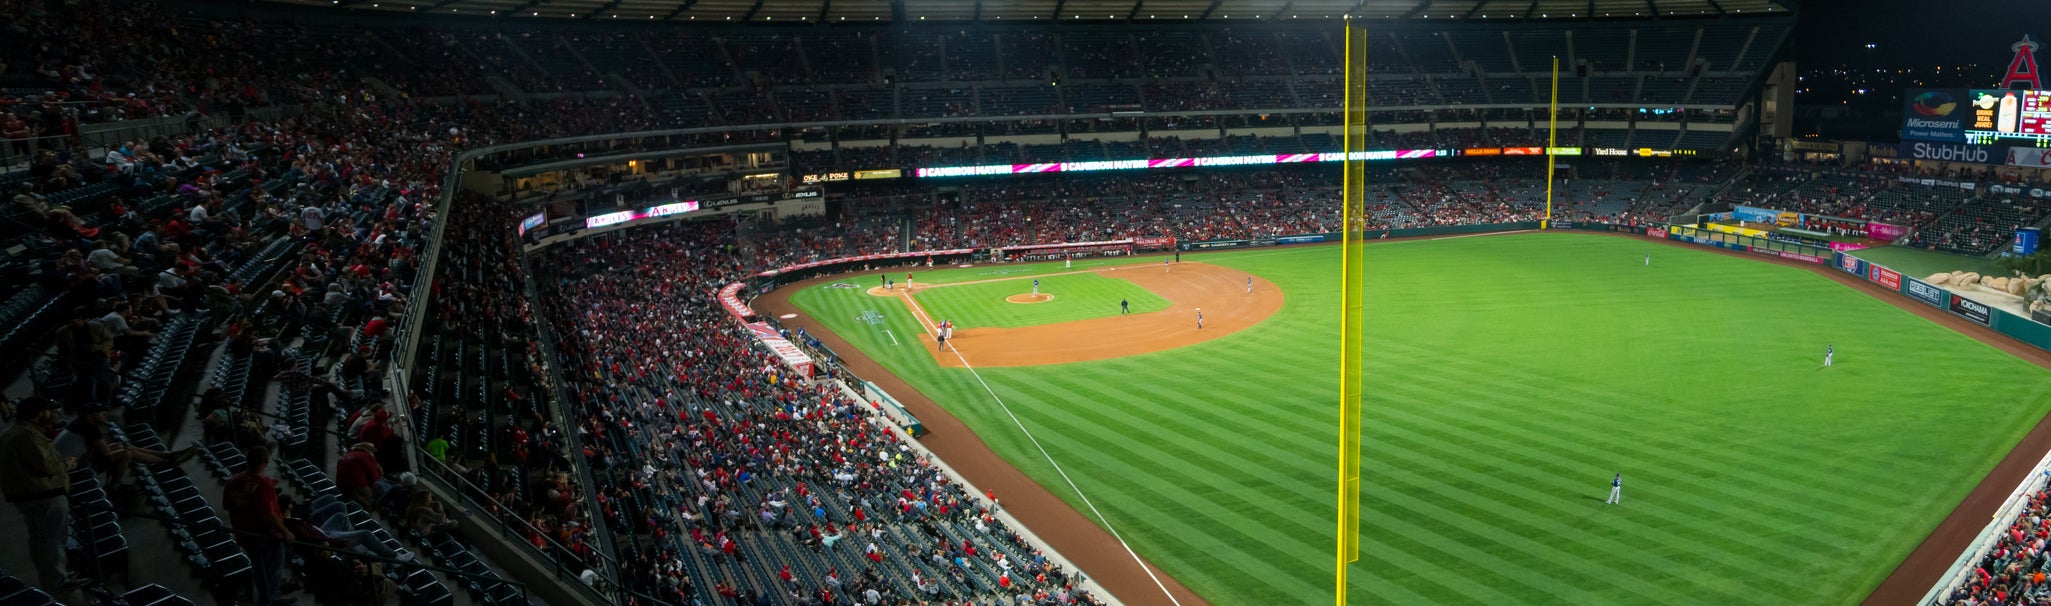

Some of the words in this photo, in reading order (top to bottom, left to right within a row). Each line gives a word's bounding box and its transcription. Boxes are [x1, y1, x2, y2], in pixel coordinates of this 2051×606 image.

[1907, 118, 1959, 129] Microsemi
[1366, 151, 1396, 160] MAYBIN
[1913, 142, 1988, 162] StubHub
[1068, 162, 1113, 171] CAMERON
[1114, 160, 1148, 169] MAYBIN
[1201, 157, 1243, 165] CAMERON
[1244, 155, 1276, 164] MAYBIN
[928, 167, 975, 176] CAMERON
[976, 165, 1012, 175] MAYBIN
[1935, 179, 1959, 187] StubHub
[1780, 252, 1799, 260] UNLIMITED
[1800, 255, 1818, 263] BASEBALL
[1960, 298, 1988, 316] YOKOHAMA
